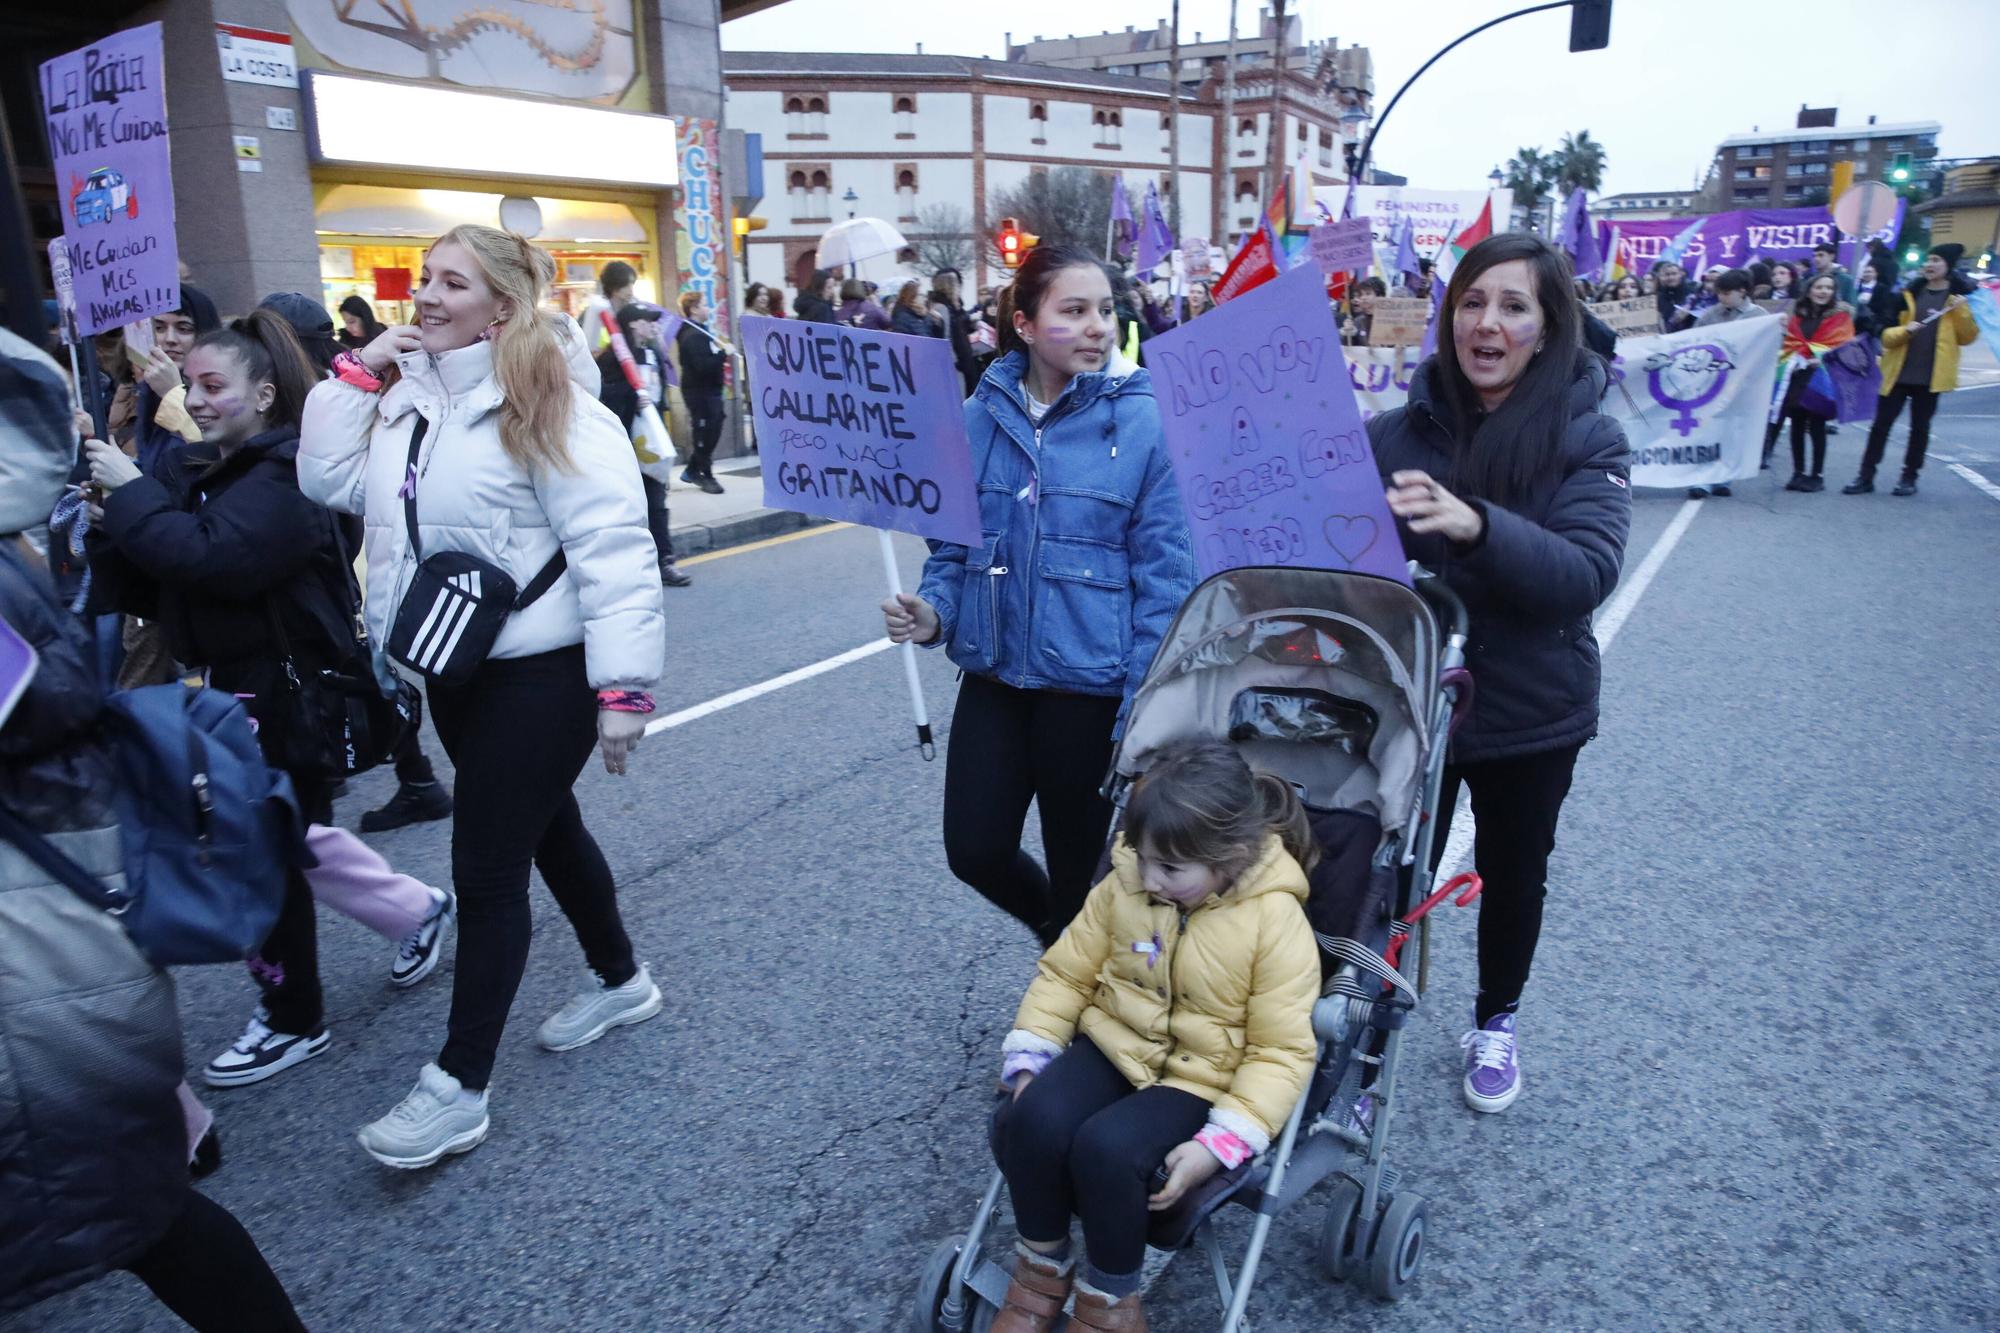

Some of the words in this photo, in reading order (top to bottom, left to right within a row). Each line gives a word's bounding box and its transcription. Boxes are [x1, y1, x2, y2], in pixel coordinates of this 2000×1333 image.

[225, 55, 244, 74] LA
[246, 57, 294, 79] COSTA
[49, 118, 79, 159] NO
[1719, 234, 1741, 259] Y
[1159, 341, 1232, 416] NO
[1238, 325, 1325, 394] VOY
[761, 386, 917, 440] CALLARME
[1230, 406, 1262, 456] A
[778, 462, 942, 514] GRITANDO
[1190, 456, 1297, 520] CRECER
[1300, 430, 1366, 479] CON
[345, 743, 356, 769] FILA
